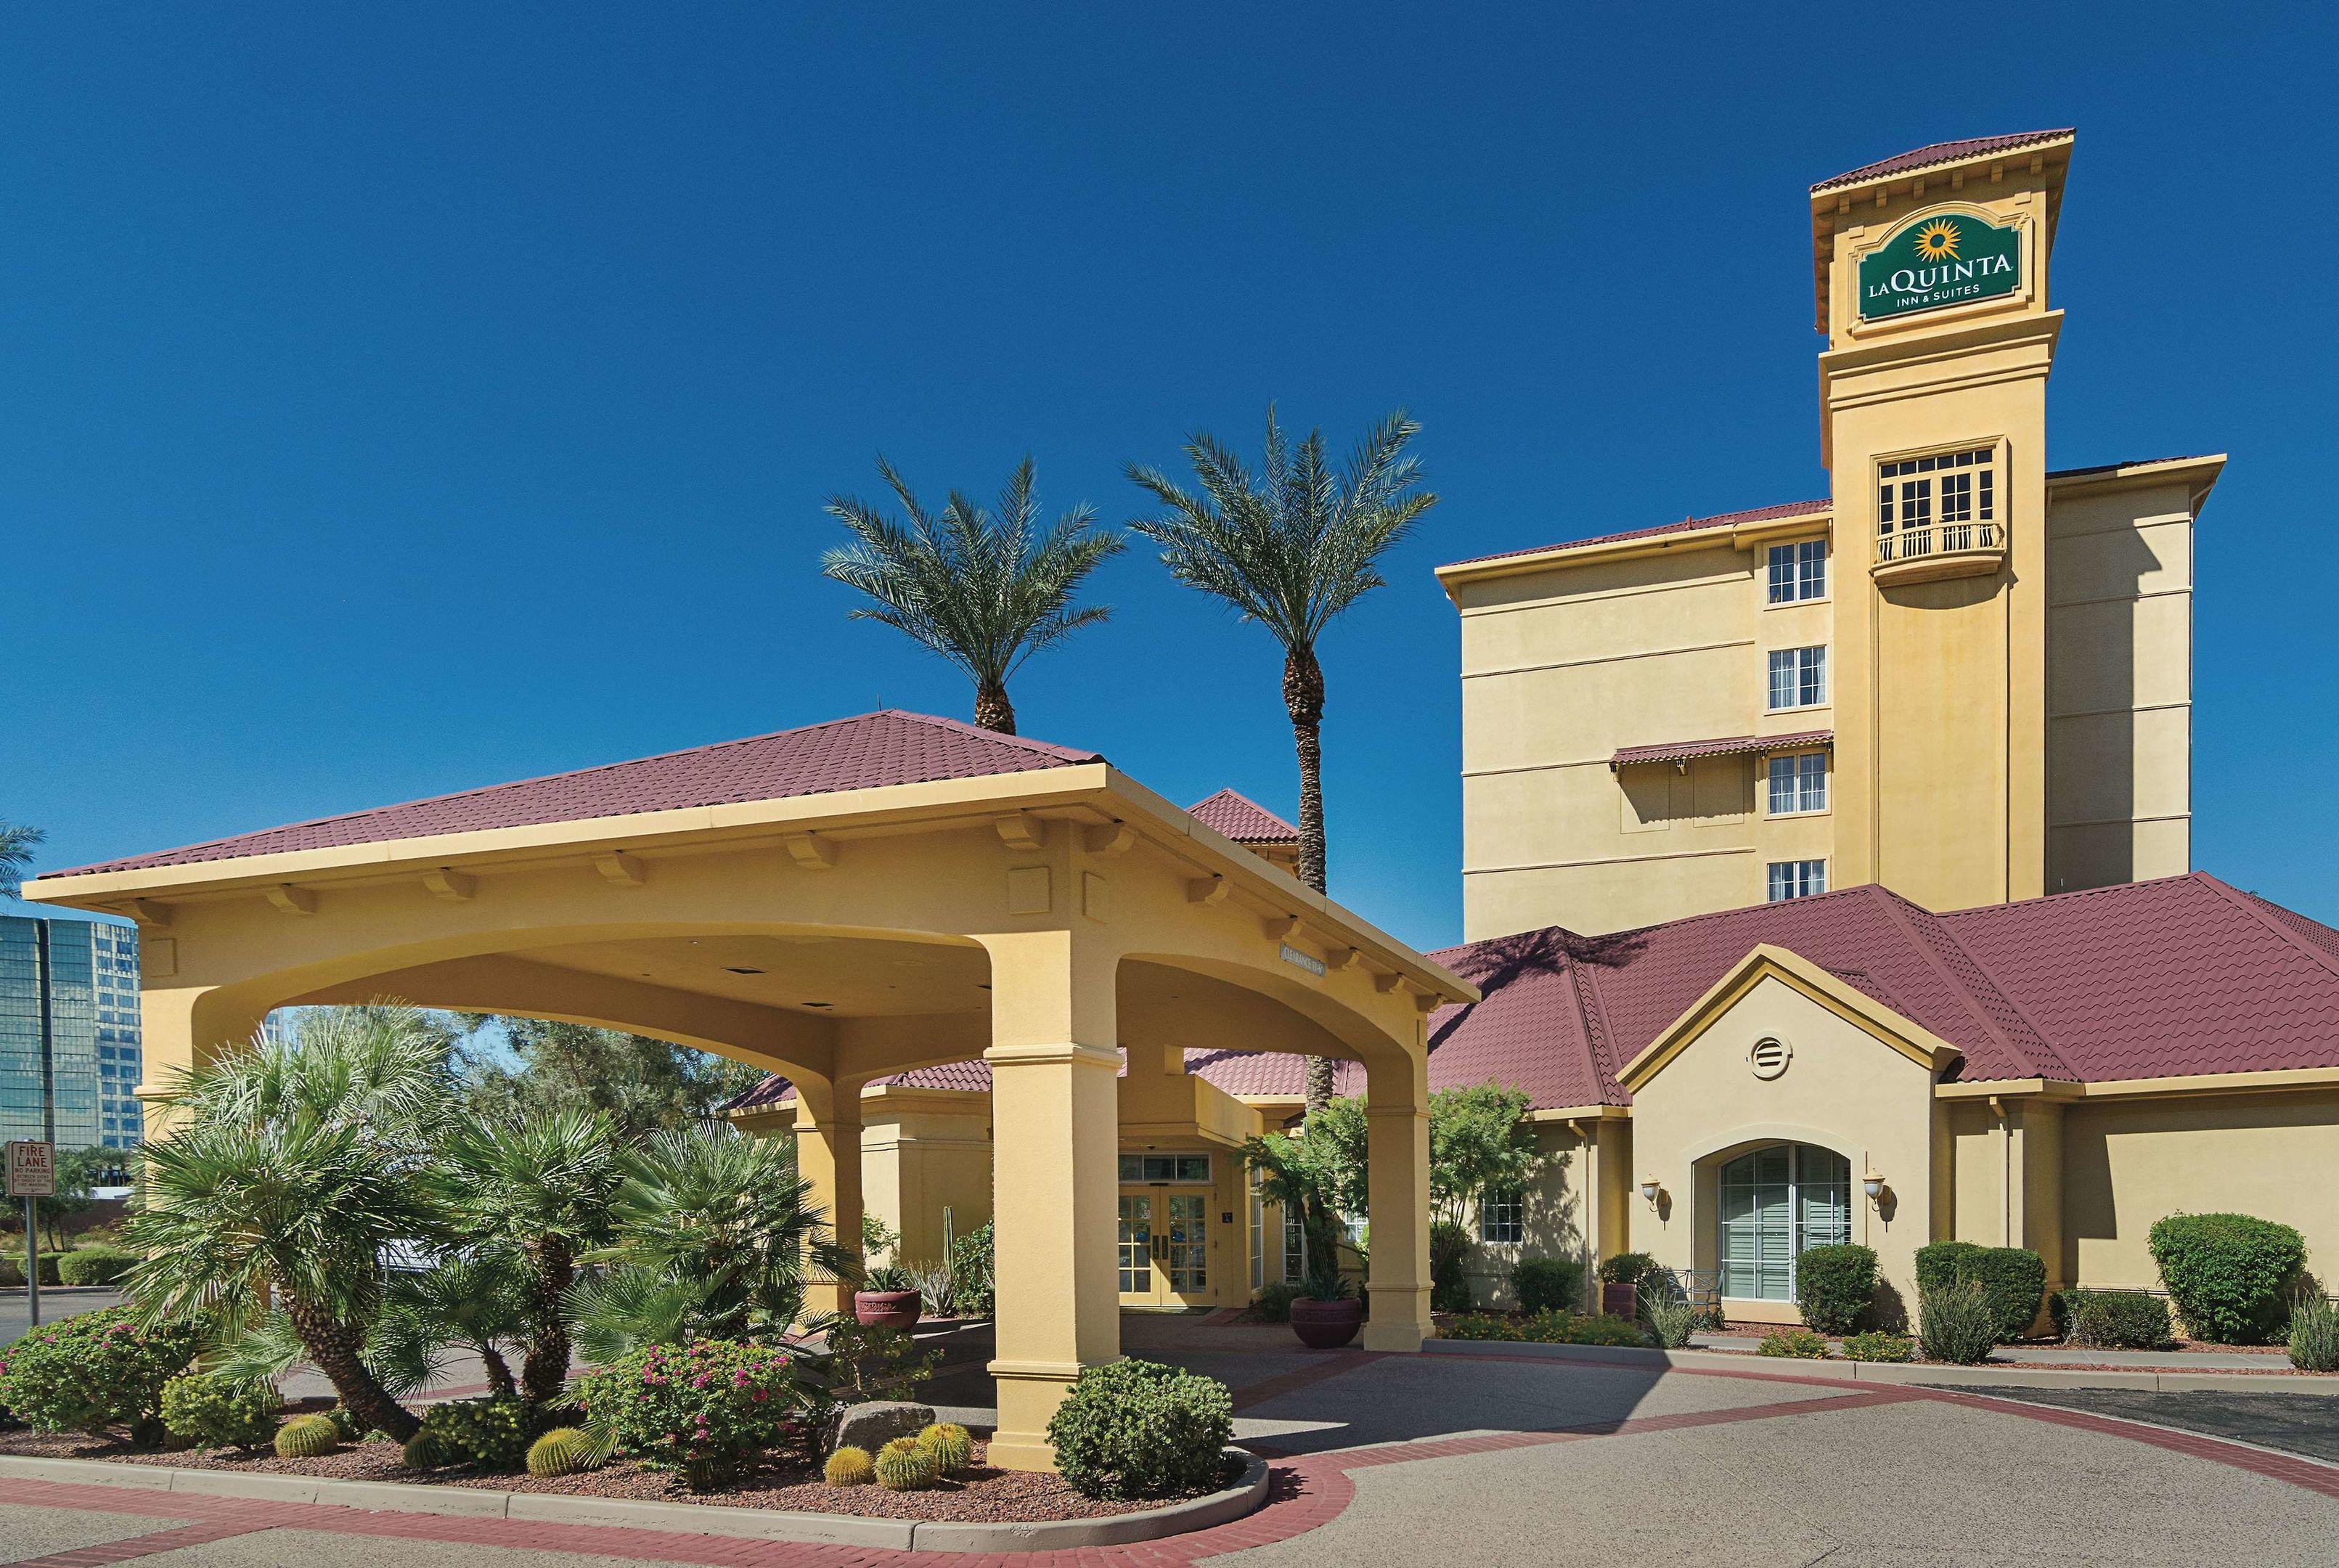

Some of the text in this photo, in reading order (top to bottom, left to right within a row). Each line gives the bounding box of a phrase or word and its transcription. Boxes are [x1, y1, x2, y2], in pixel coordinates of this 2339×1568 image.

[1868, 254, 2012, 298] LA QUINTA
[1897, 295, 1919, 307] INN
[1933, 284, 1980, 301] SUITES
[19, 1146, 45, 1156] FIRE
[17, 1156, 47, 1167] LANE
